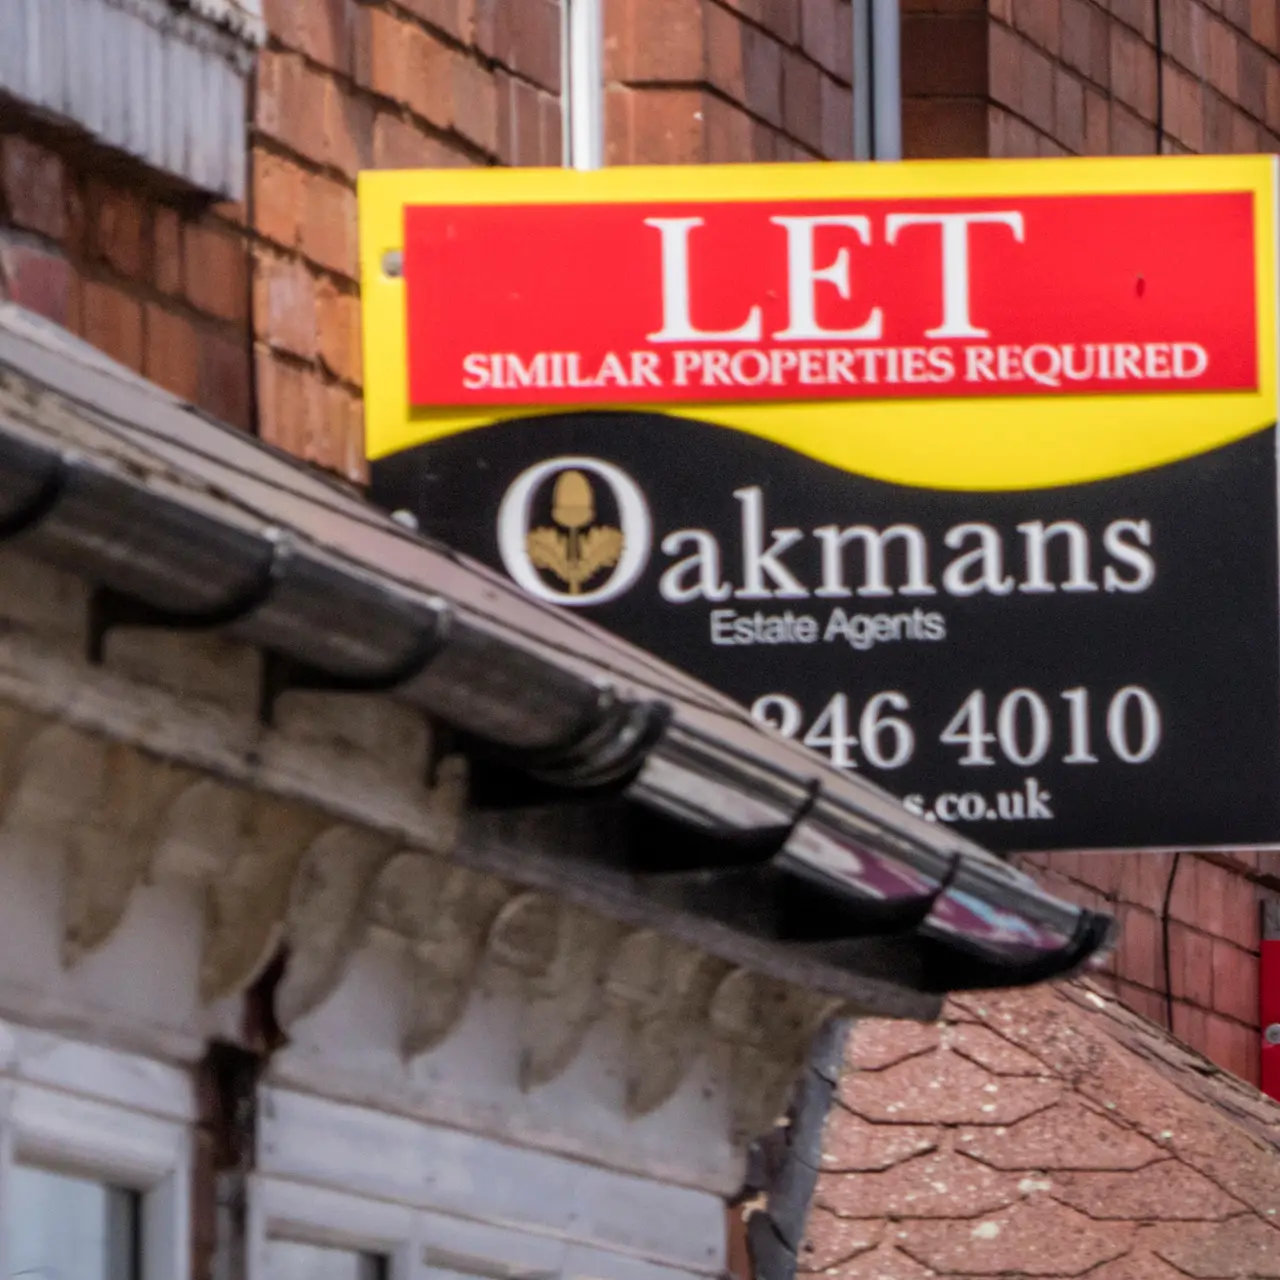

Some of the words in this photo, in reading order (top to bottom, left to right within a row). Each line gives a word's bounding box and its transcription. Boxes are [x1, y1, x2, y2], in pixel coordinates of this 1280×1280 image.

[645, 211, 1026, 343] LET
[461, 352, 662, 390] SIMILAR
[673, 346, 955, 387] PROPERTIES
[964, 341, 1209, 384] REQUIRED
[497, 455, 1156, 606] Oakmans
[711, 610, 818, 646] Estate
[824, 606, 946, 650] Agents
[939, 686, 1162, 766] 4010
